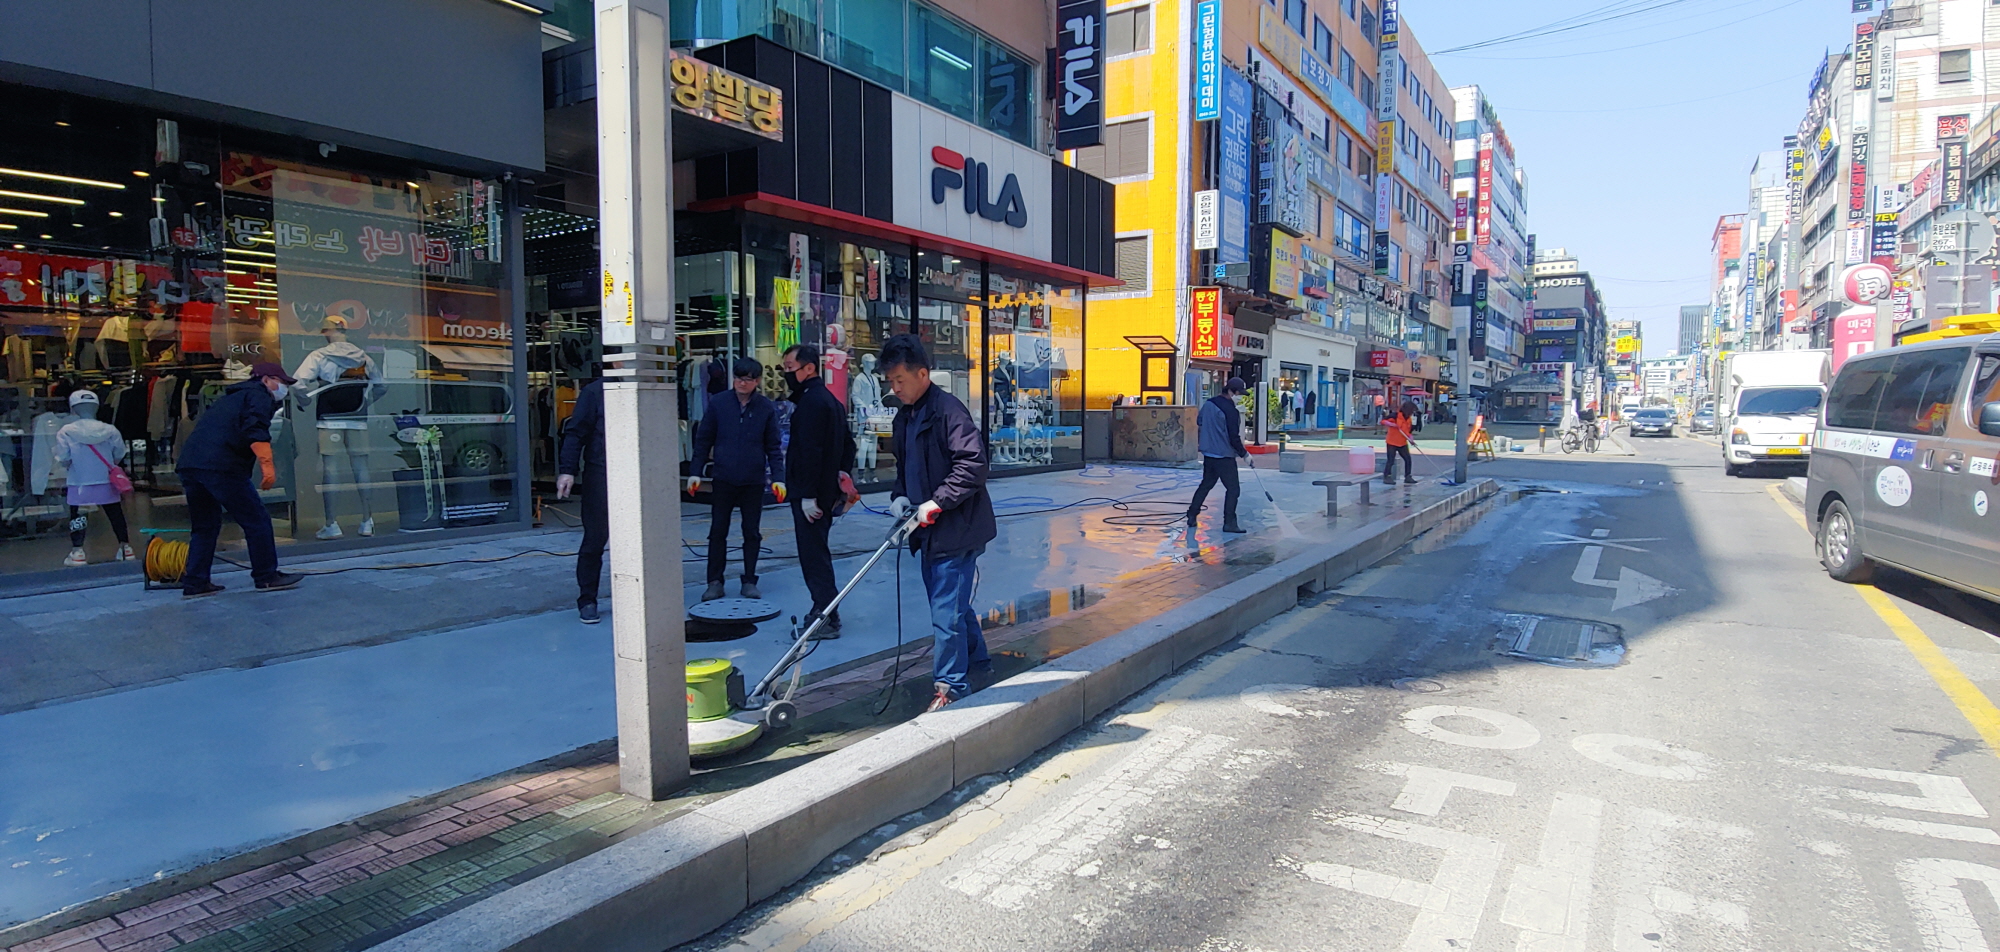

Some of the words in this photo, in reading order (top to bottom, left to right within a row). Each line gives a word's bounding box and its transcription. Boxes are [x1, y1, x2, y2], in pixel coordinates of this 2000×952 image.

[1065, 15, 1093, 115] FILA
[1202, 4, 1215, 108] 그린컴퓨터아카데미
[1880, 45, 1892, 90] 스포츠마사지
[1855, 76, 1871, 87] 6F
[1224, 106, 1247, 146] 그린
[1225, 136, 1247, 166] 컴퓨터
[1852, 135, 1867, 160] 쇼킹
[931, 145, 1027, 229] FILA
[1946, 169, 1961, 202] 게임장
[1875, 213, 1900, 222] 7EV
[1196, 291, 1216, 302] 동성
[1540, 278, 1585, 287] HOTEL
[1197, 303, 1215, 350] 부동산
[1847, 318, 1875, 328] 마라
